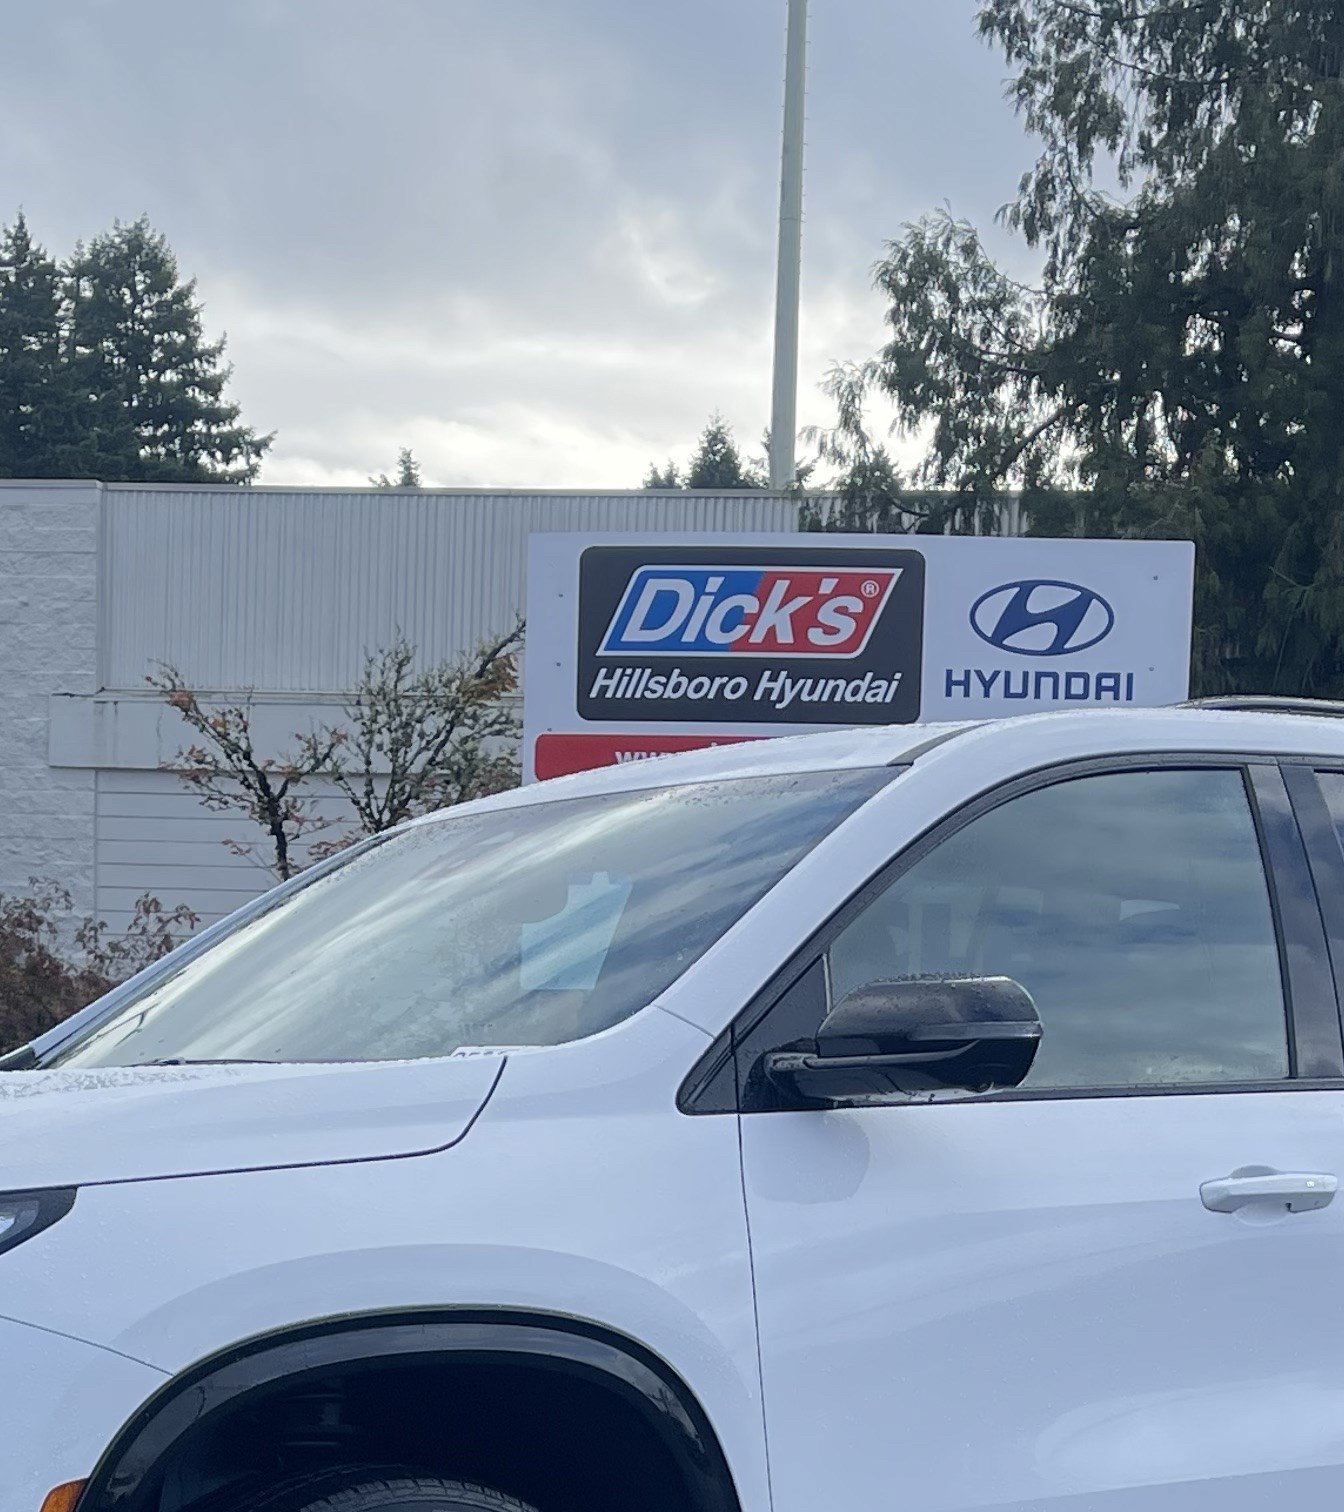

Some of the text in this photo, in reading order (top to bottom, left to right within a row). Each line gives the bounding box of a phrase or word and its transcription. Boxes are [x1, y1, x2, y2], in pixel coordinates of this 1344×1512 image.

[619, 576, 865, 646] Dick's
[589, 666, 902, 709] Hillsboro Hyundai
[944, 668, 1135, 702] HYUNDAI
